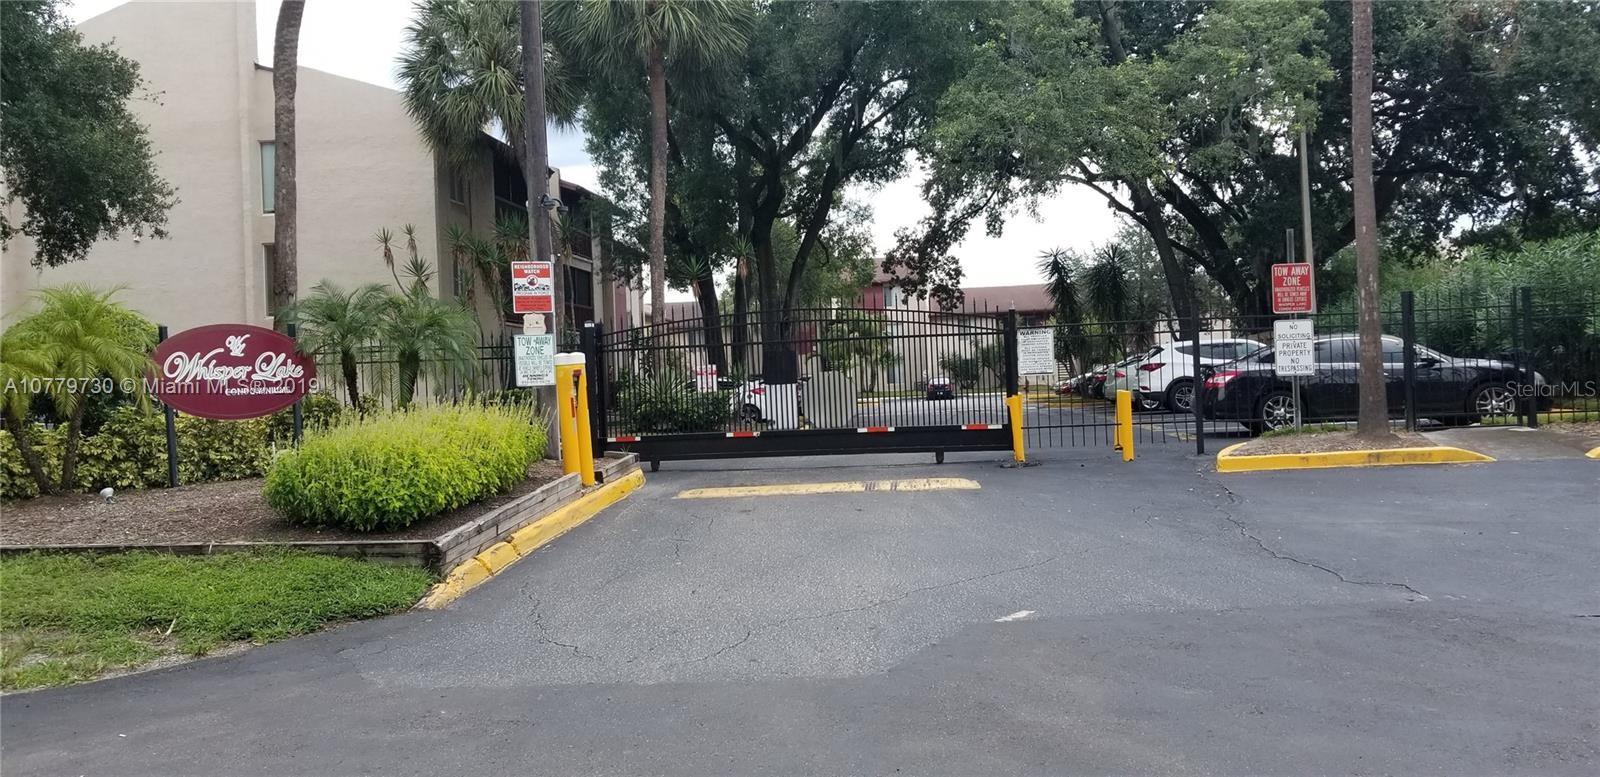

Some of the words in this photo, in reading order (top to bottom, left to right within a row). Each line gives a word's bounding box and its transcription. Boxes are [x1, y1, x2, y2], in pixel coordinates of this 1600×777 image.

[1274, 267, 1288, 276] TOW
[1291, 266, 1309, 276] AWAY
[1283, 277, 1301, 286] ZONE
[525, 346, 544, 355] ZONE
[1279, 349, 1311, 357] PROPERTY
[163, 347, 253, 385] Whisper
[251, 351, 304, 381] Lake
[1278, 365, 1312, 373] TRESPASSING
